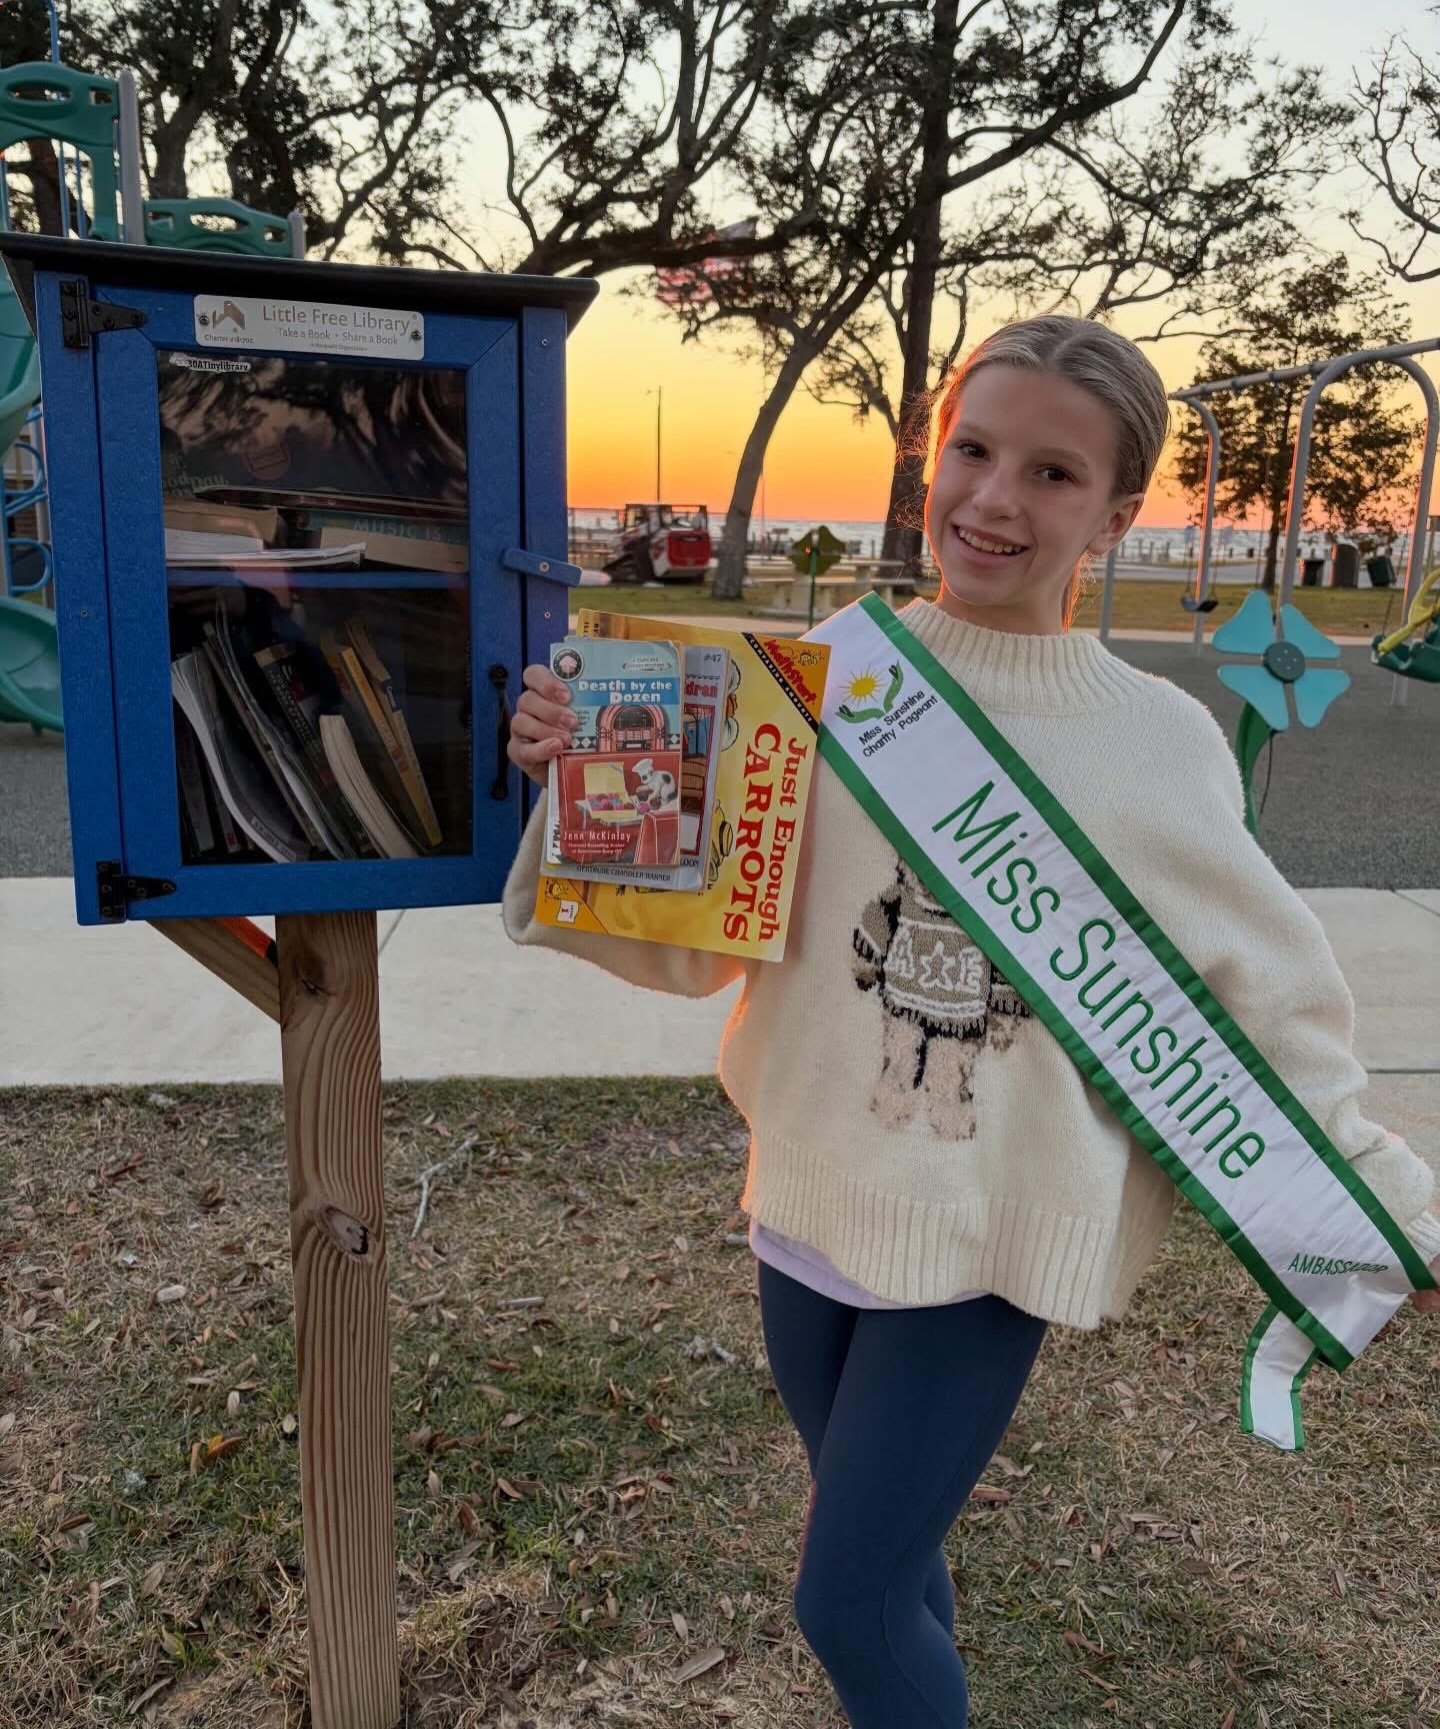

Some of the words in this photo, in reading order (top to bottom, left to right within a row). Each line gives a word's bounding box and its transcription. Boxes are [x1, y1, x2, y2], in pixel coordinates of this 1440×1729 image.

[262, 305, 307, 323] Little
[312, 309, 348, 326] Free
[353, 312, 410, 336] Library
[278, 327, 299, 338] Take
[308, 329, 331, 340] Book
[342, 331, 367, 343] Share
[376, 336, 398, 346] Book
[703, 654, 722, 663] #47
[579, 680, 626, 691] Death
[630, 682, 645, 692] by
[651, 680, 673, 690] the
[685, 680, 718, 698] dren
[750, 639, 784, 684] COMPARING
[784, 687, 812, 722] AMOUNTS
[609, 691, 661, 704] Dozen
[858, 725, 882, 745] Miss
[884, 690, 925, 726] Sunshine
[862, 728, 897, 757] Charity
[898, 695, 938, 730] Pageant
[779, 737, 808, 808] Just
[563, 830, 585, 841] Jenn
[723, 723, 782, 942] CARROTS
[610, 868, 644, 880] CHANDLER
[644, 872, 671, 883] WARNER
[758, 816, 797, 942] Enough
[932, 780, 1061, 934] Miss
[1049, 918, 1266, 1179] Sunshine
